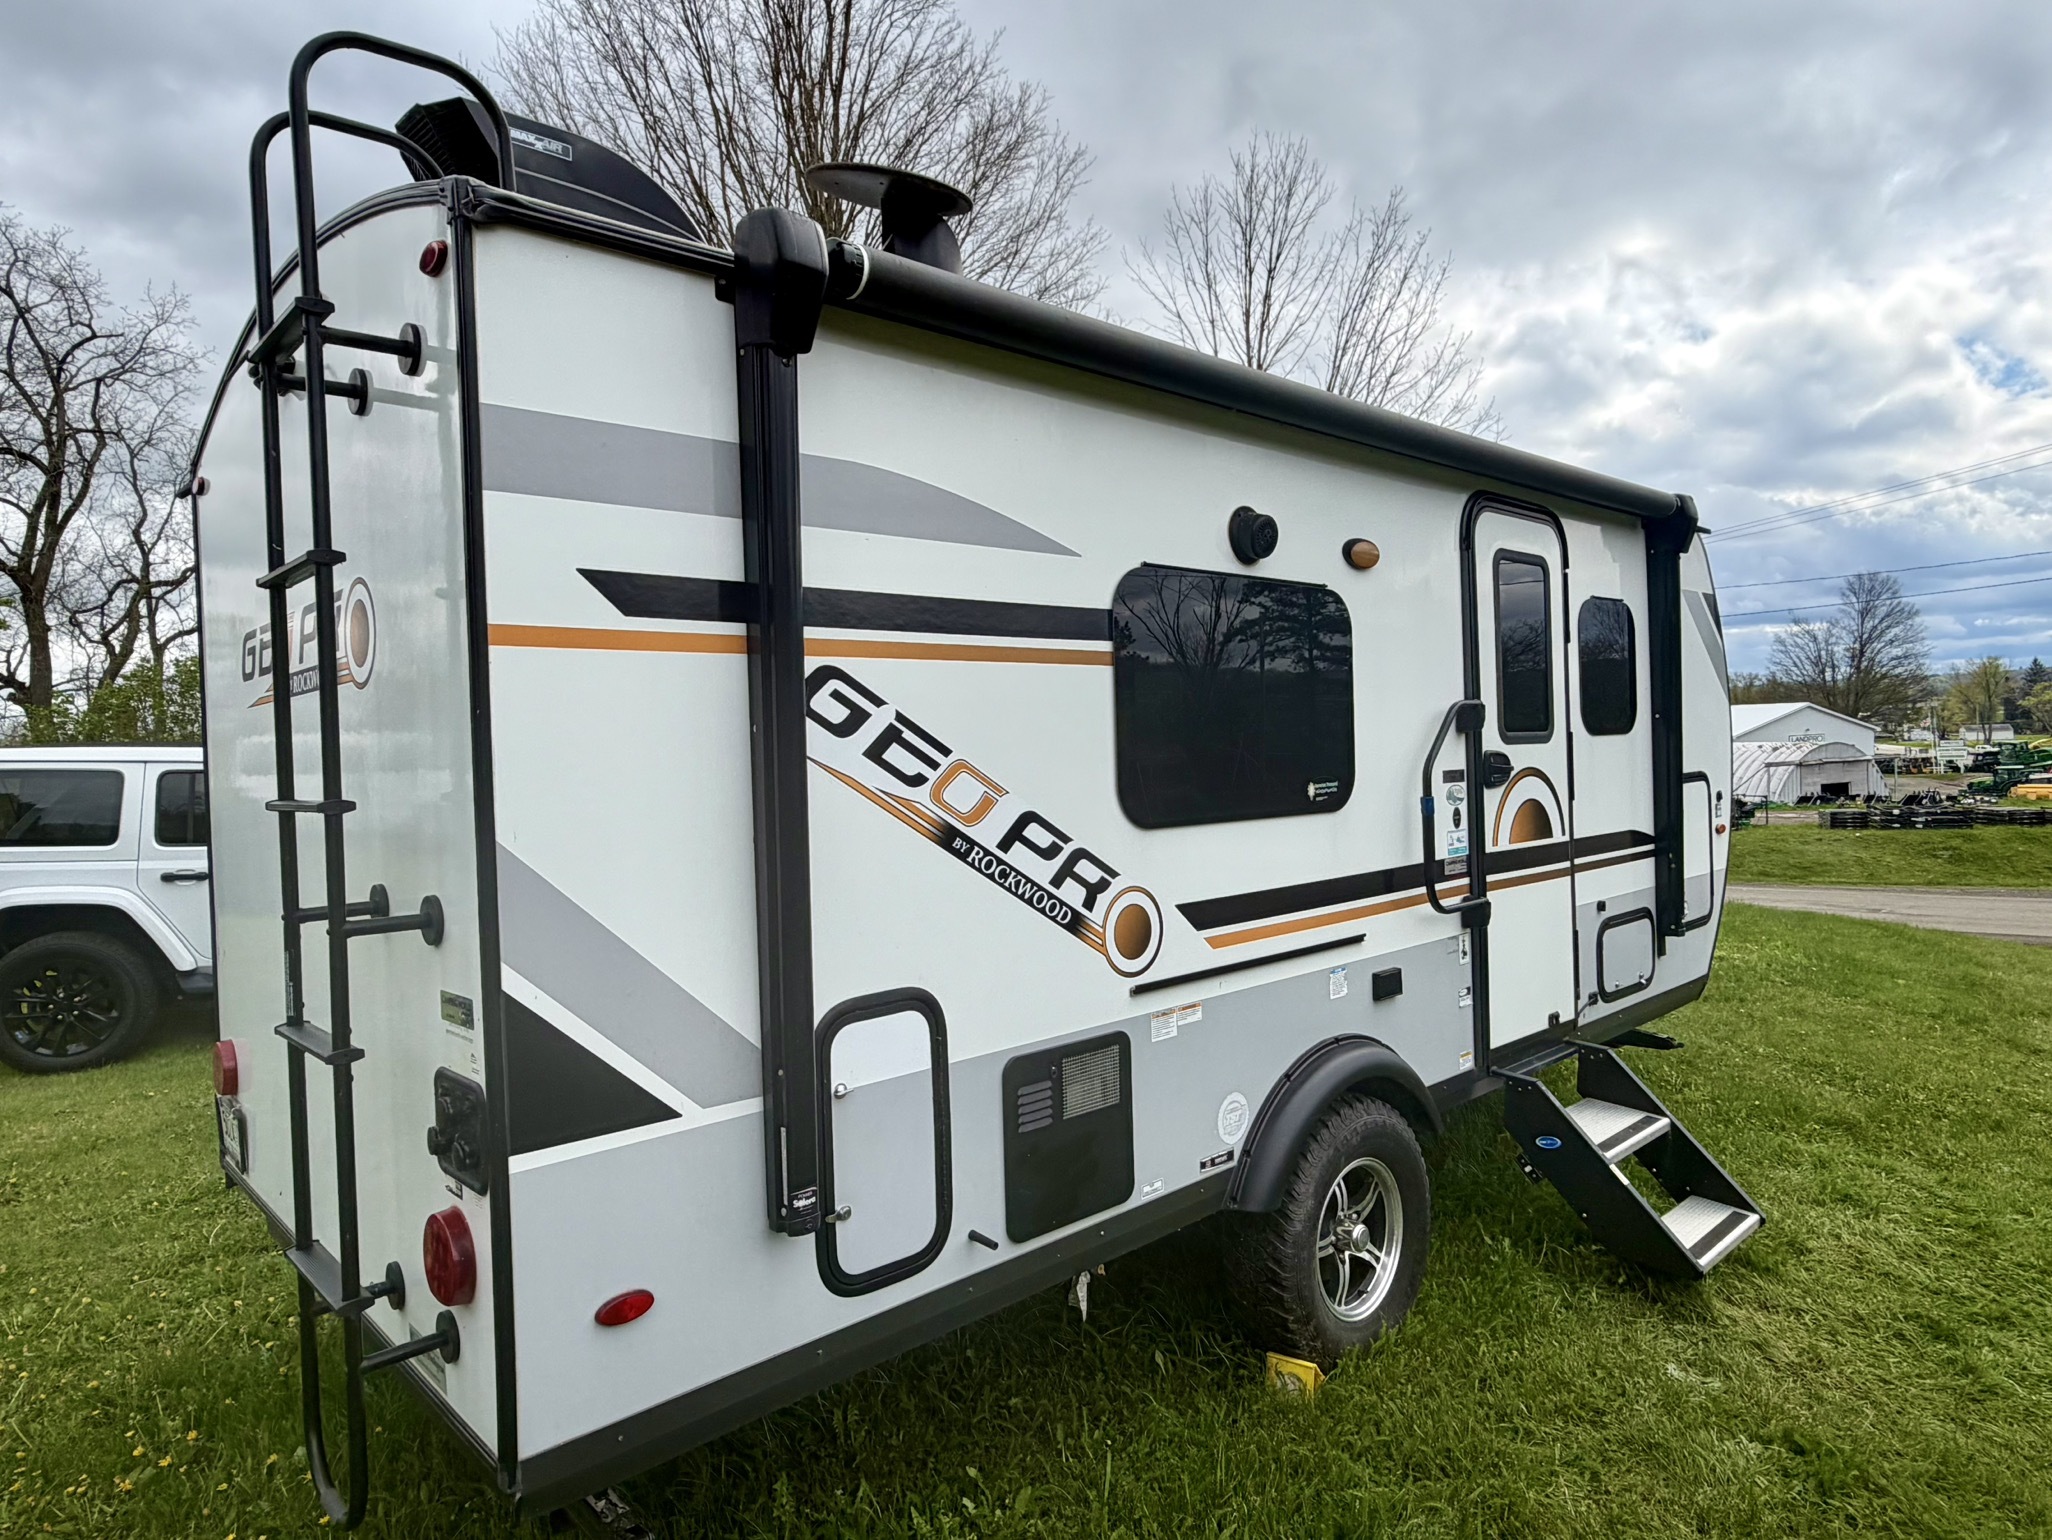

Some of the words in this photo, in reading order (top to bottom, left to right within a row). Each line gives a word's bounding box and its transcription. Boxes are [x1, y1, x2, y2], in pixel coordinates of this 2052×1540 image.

[242, 611, 296, 682] GE
[293, 669, 319, 693] ROCKW
[1791, 734, 1824, 743] LANDPRO
[805, 665, 1009, 827] GEO
[995, 810, 1164, 978] PRO
[952, 837, 970, 854] BY
[967, 846, 1072, 925] ROCKWOOD
